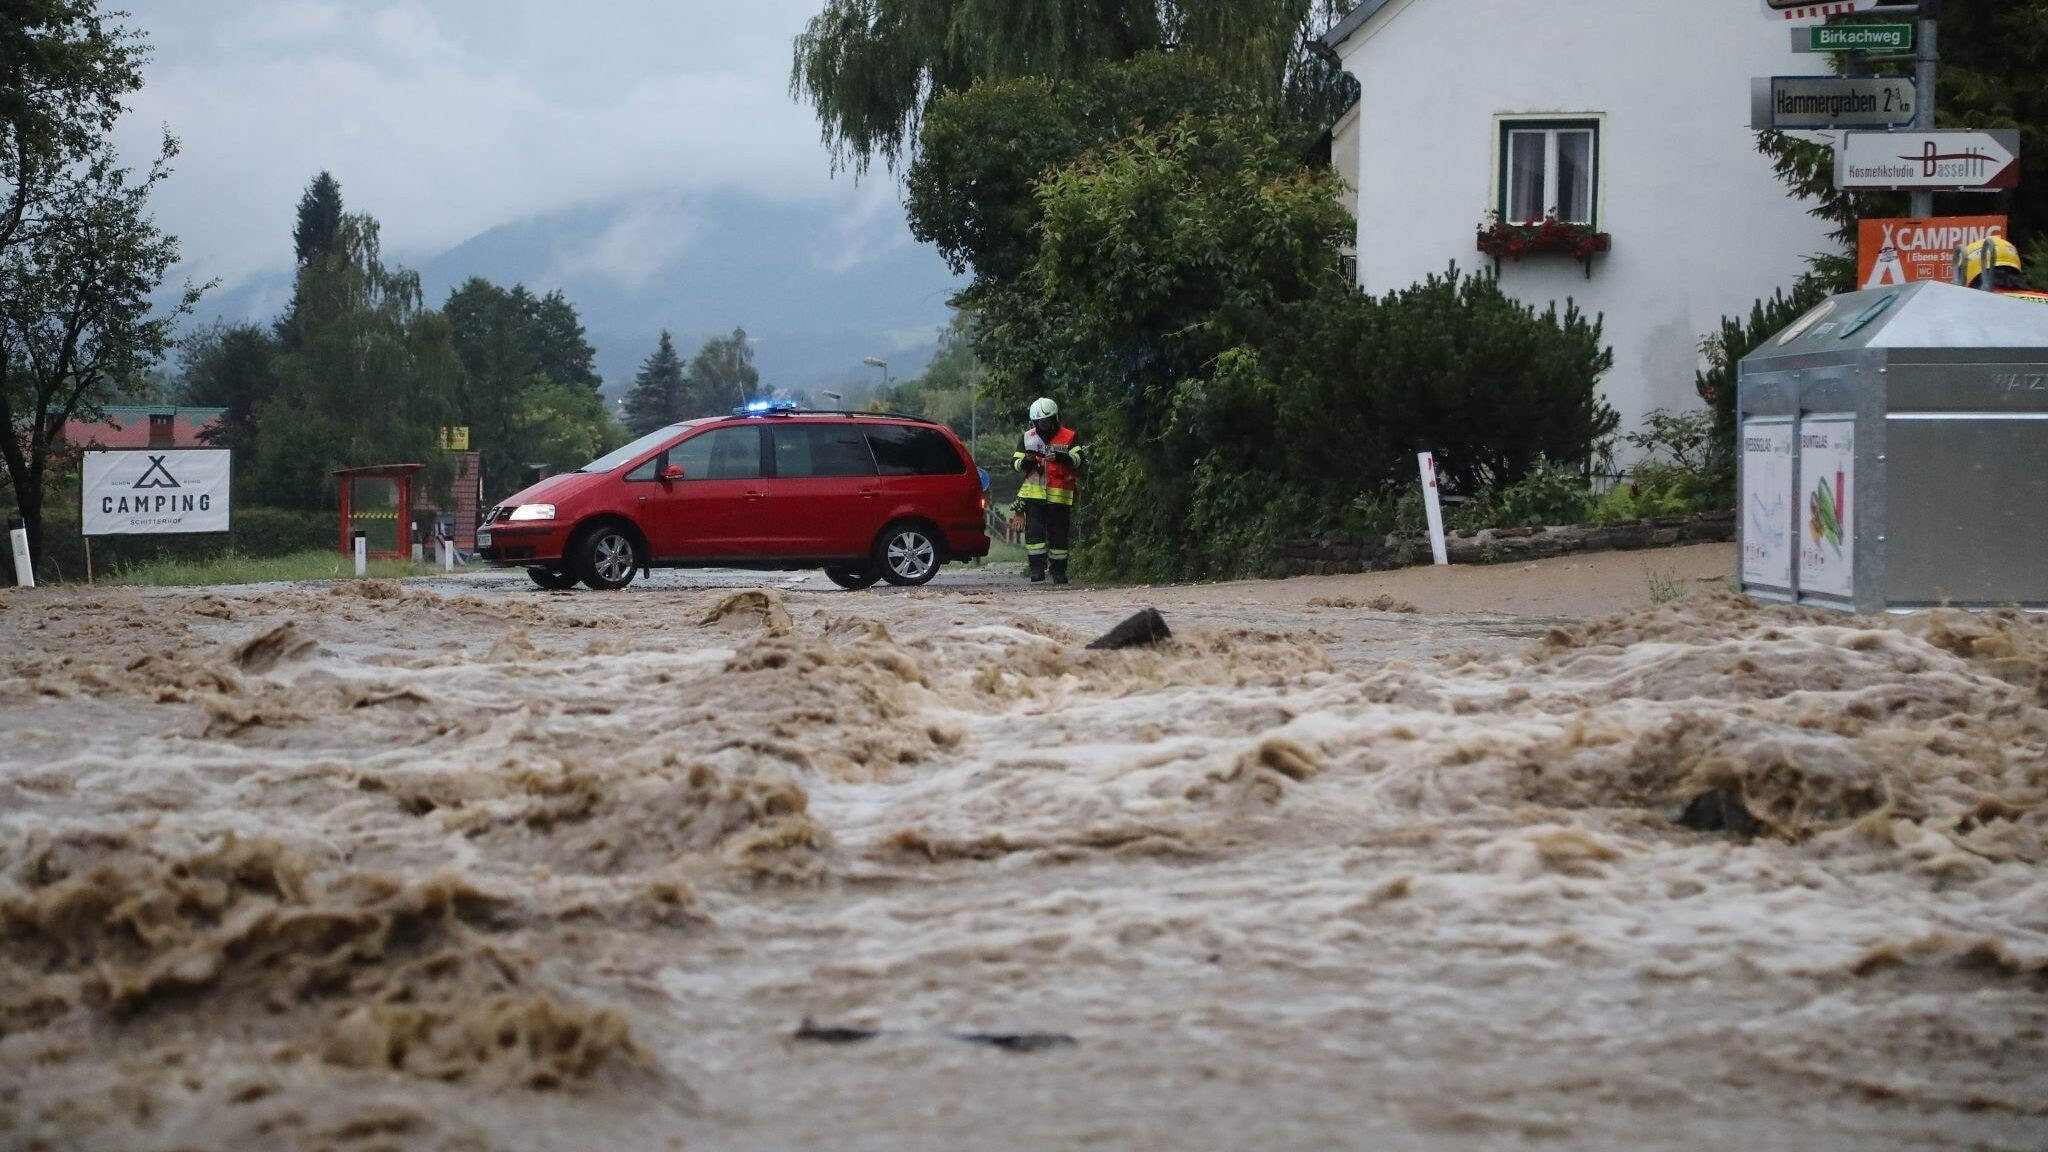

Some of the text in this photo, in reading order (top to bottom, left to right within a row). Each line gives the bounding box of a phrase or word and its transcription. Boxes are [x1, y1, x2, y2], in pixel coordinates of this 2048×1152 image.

[1820, 30, 1900, 44] Birkachweg
[1777, 88, 1877, 117] Hammergraben
[1850, 163, 1914, 178] Kosmetikstudio
[102, 494, 210, 514] CAMPING
